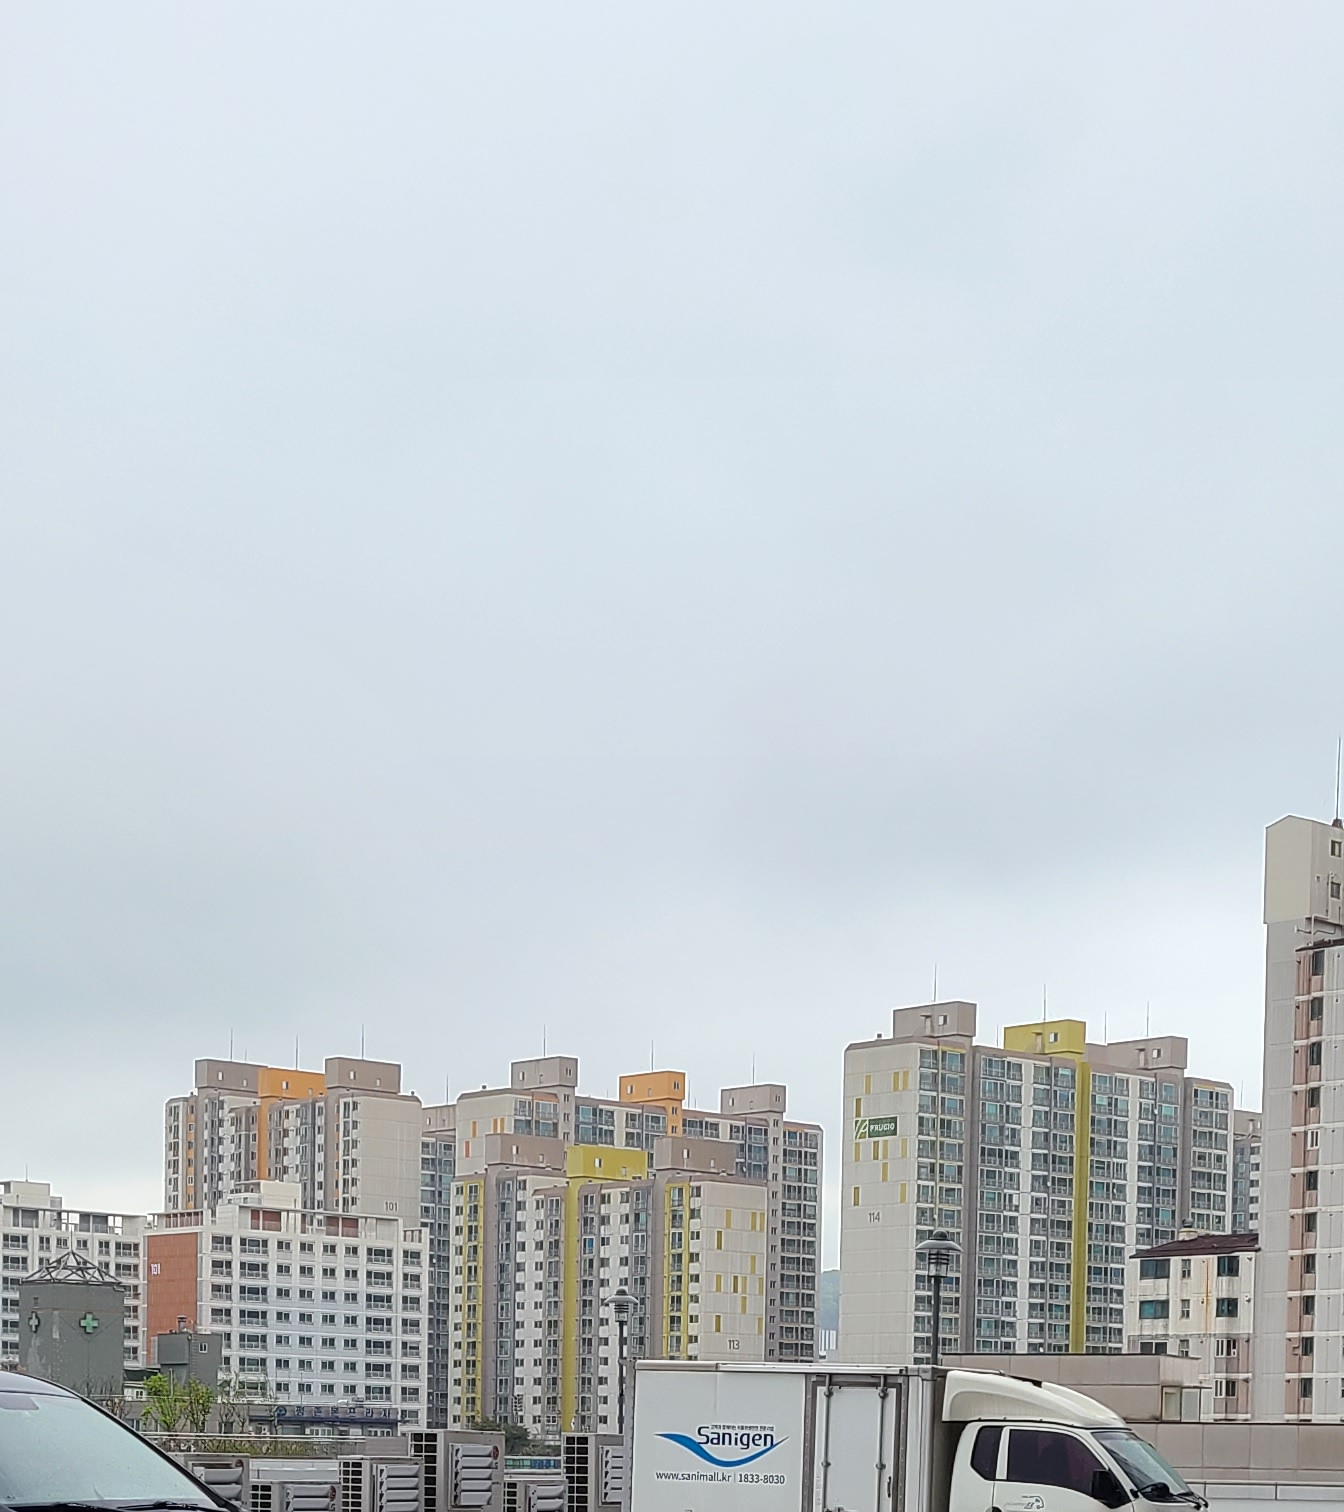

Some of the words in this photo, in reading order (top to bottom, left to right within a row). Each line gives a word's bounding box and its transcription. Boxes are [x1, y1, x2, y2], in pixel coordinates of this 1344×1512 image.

[385, 1200, 398, 1212] 101
[868, 1211, 881, 1223] 114
[728, 1339, 740, 1350] 113
[697, 1426, 774, 1450] Sanigen
[655, 1471, 732, 1483] www.sanimall.kr
[738, 1473, 786, 1485] 1833-8030
